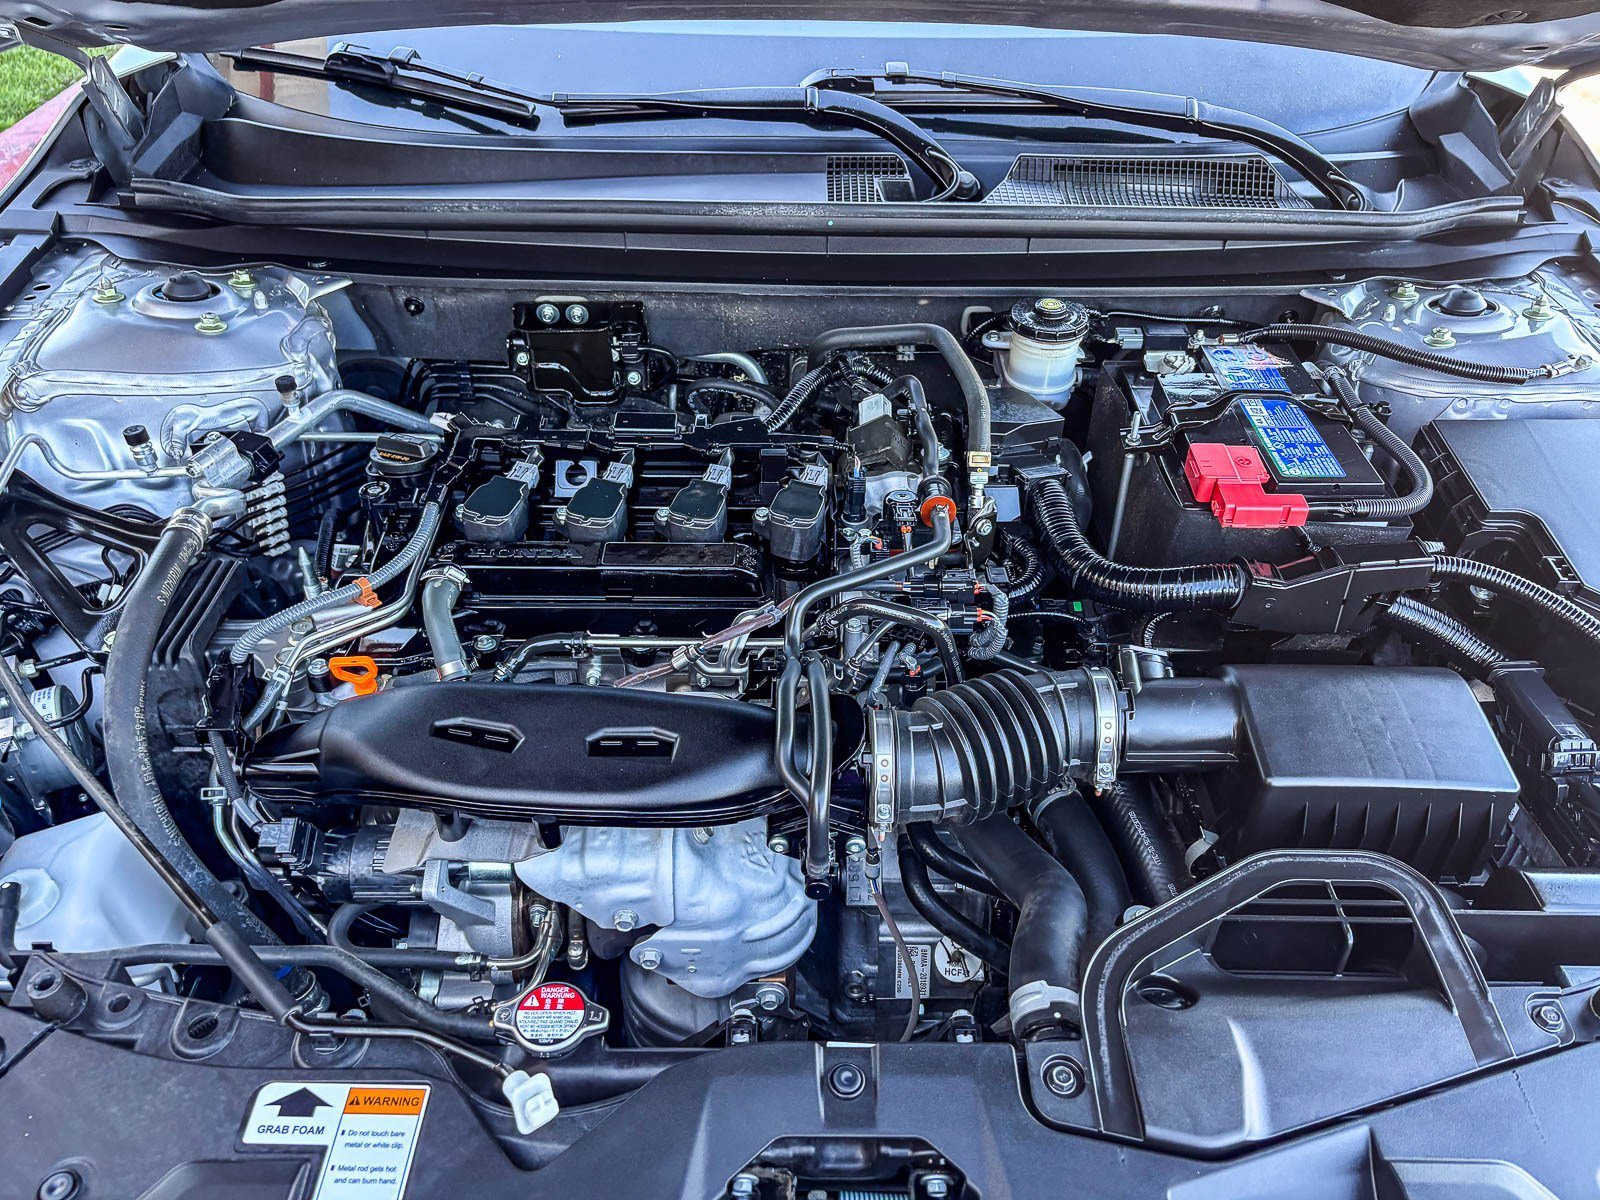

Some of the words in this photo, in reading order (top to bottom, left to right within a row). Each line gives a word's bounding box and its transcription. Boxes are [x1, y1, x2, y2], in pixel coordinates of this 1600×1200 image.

[468, 548, 582, 558] HONDA
[363, 1096, 420, 1106] WARNING
[257, 1124, 290, 1134] GRAB
[292, 1126, 325, 1135] FOAM
[391, 1142, 404, 1150] clip.
